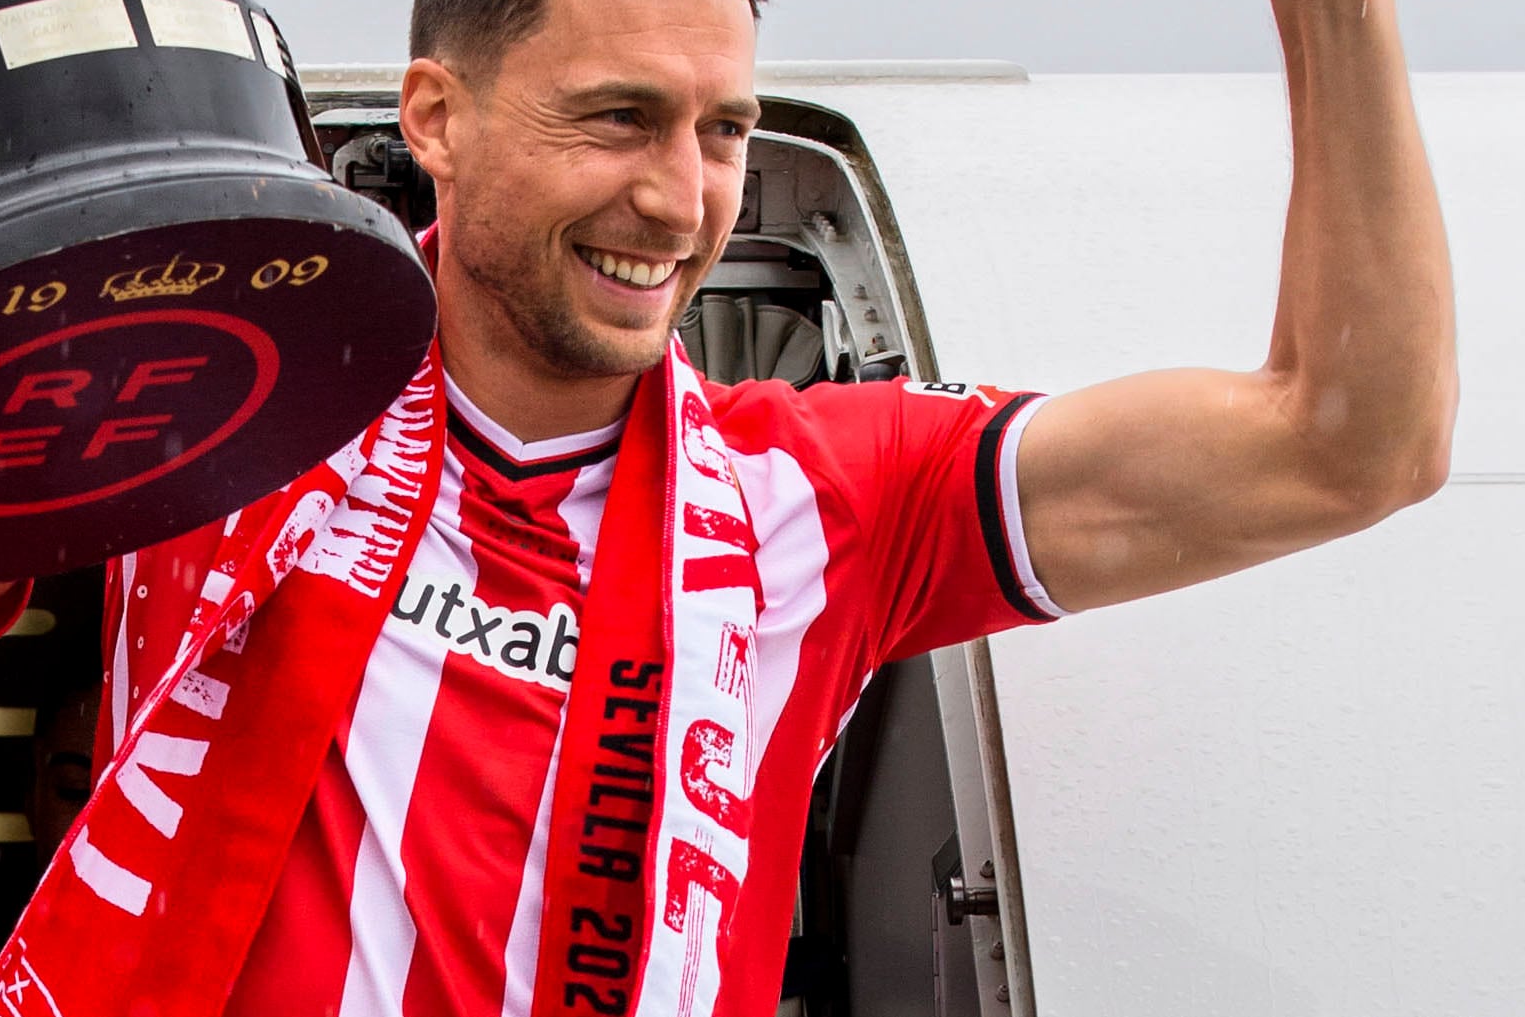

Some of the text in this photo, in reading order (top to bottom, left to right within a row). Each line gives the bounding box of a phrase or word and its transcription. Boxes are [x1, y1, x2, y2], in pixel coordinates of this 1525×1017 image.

[2, 255, 330, 314] 19 09
[578, 660, 664, 884] SEVILLA
